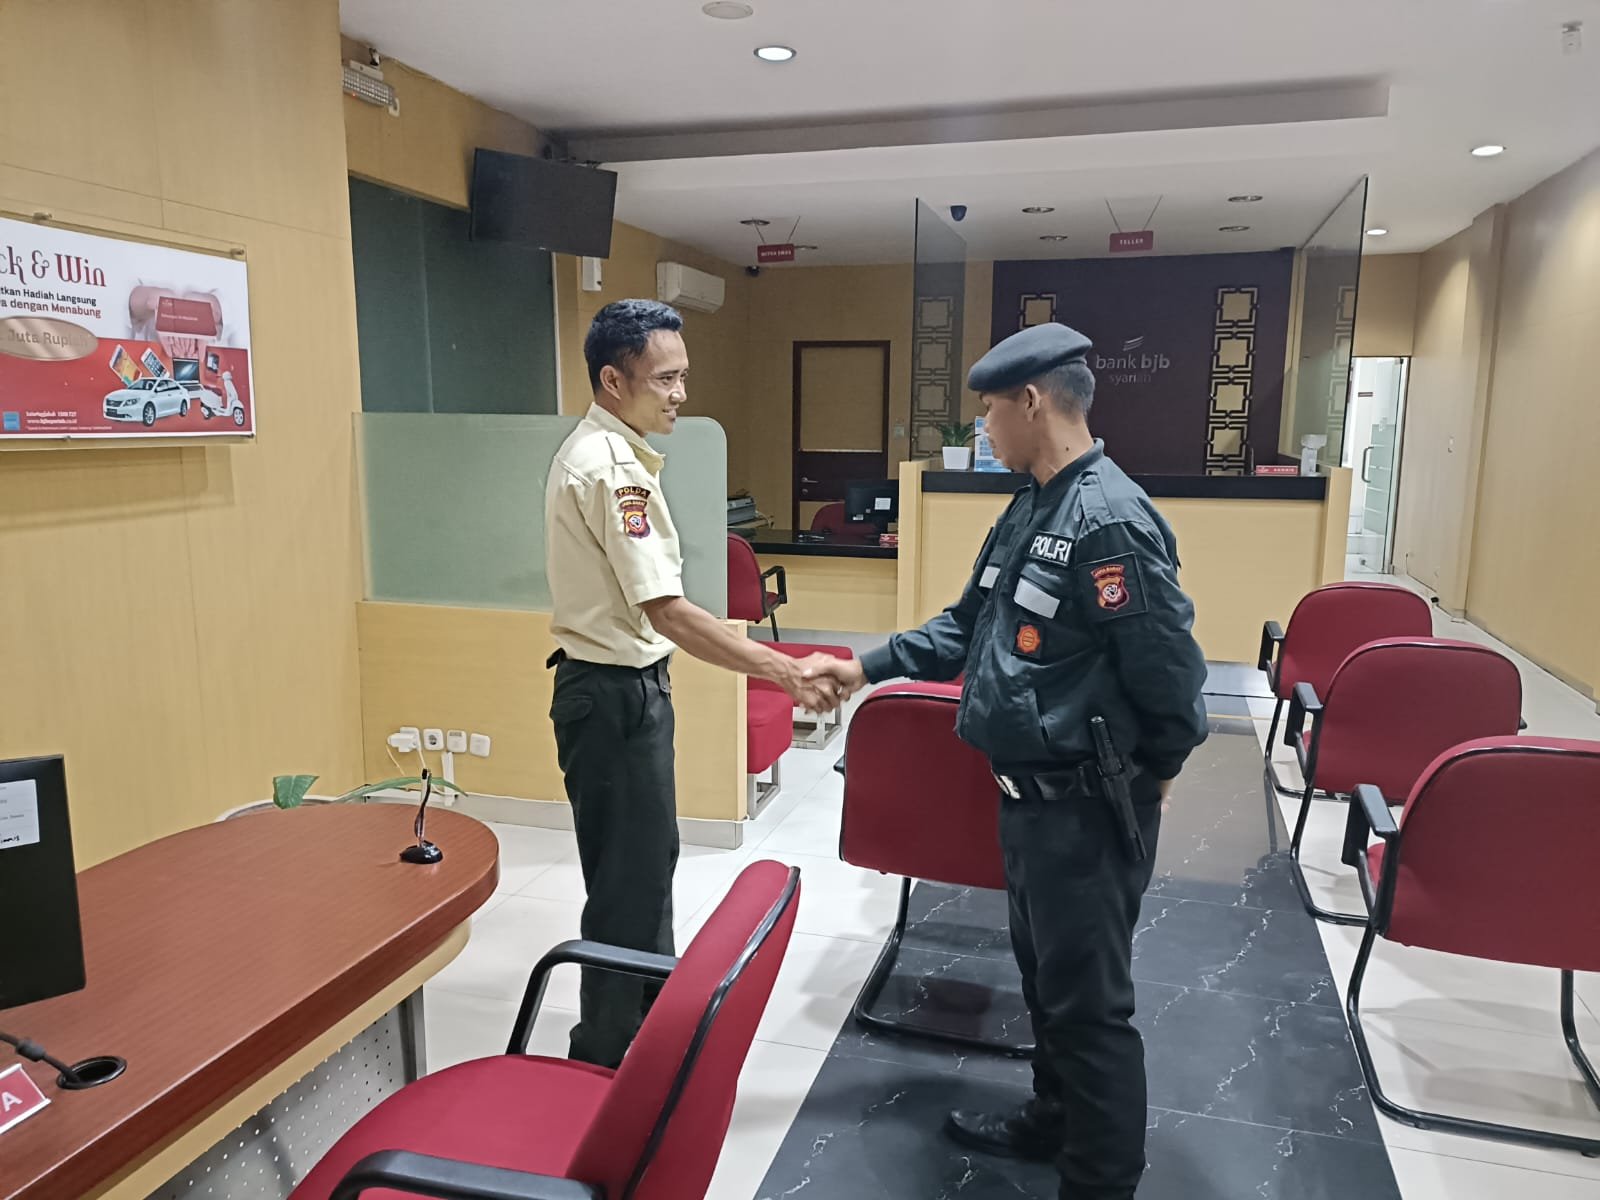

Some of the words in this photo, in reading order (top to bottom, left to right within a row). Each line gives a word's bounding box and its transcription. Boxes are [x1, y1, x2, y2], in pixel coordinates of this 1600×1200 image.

[31, 250, 50, 279] &
[54, 253, 107, 287] Win
[23, 288, 55, 301] Hadiah
[56, 292, 97, 306] Langsung
[0, 299, 8, 308] a
[10, 298, 49, 312] dengan
[51, 303, 102, 319] Menabung
[8, 328, 40, 343] Juta
[1095, 353, 1137, 369] bank
[1140, 353, 1170, 373] bjb
[1110, 373, 1152, 386] syarih
[617, 486, 647, 498] POLDA
[1029, 535, 1072, 563] POLRI
